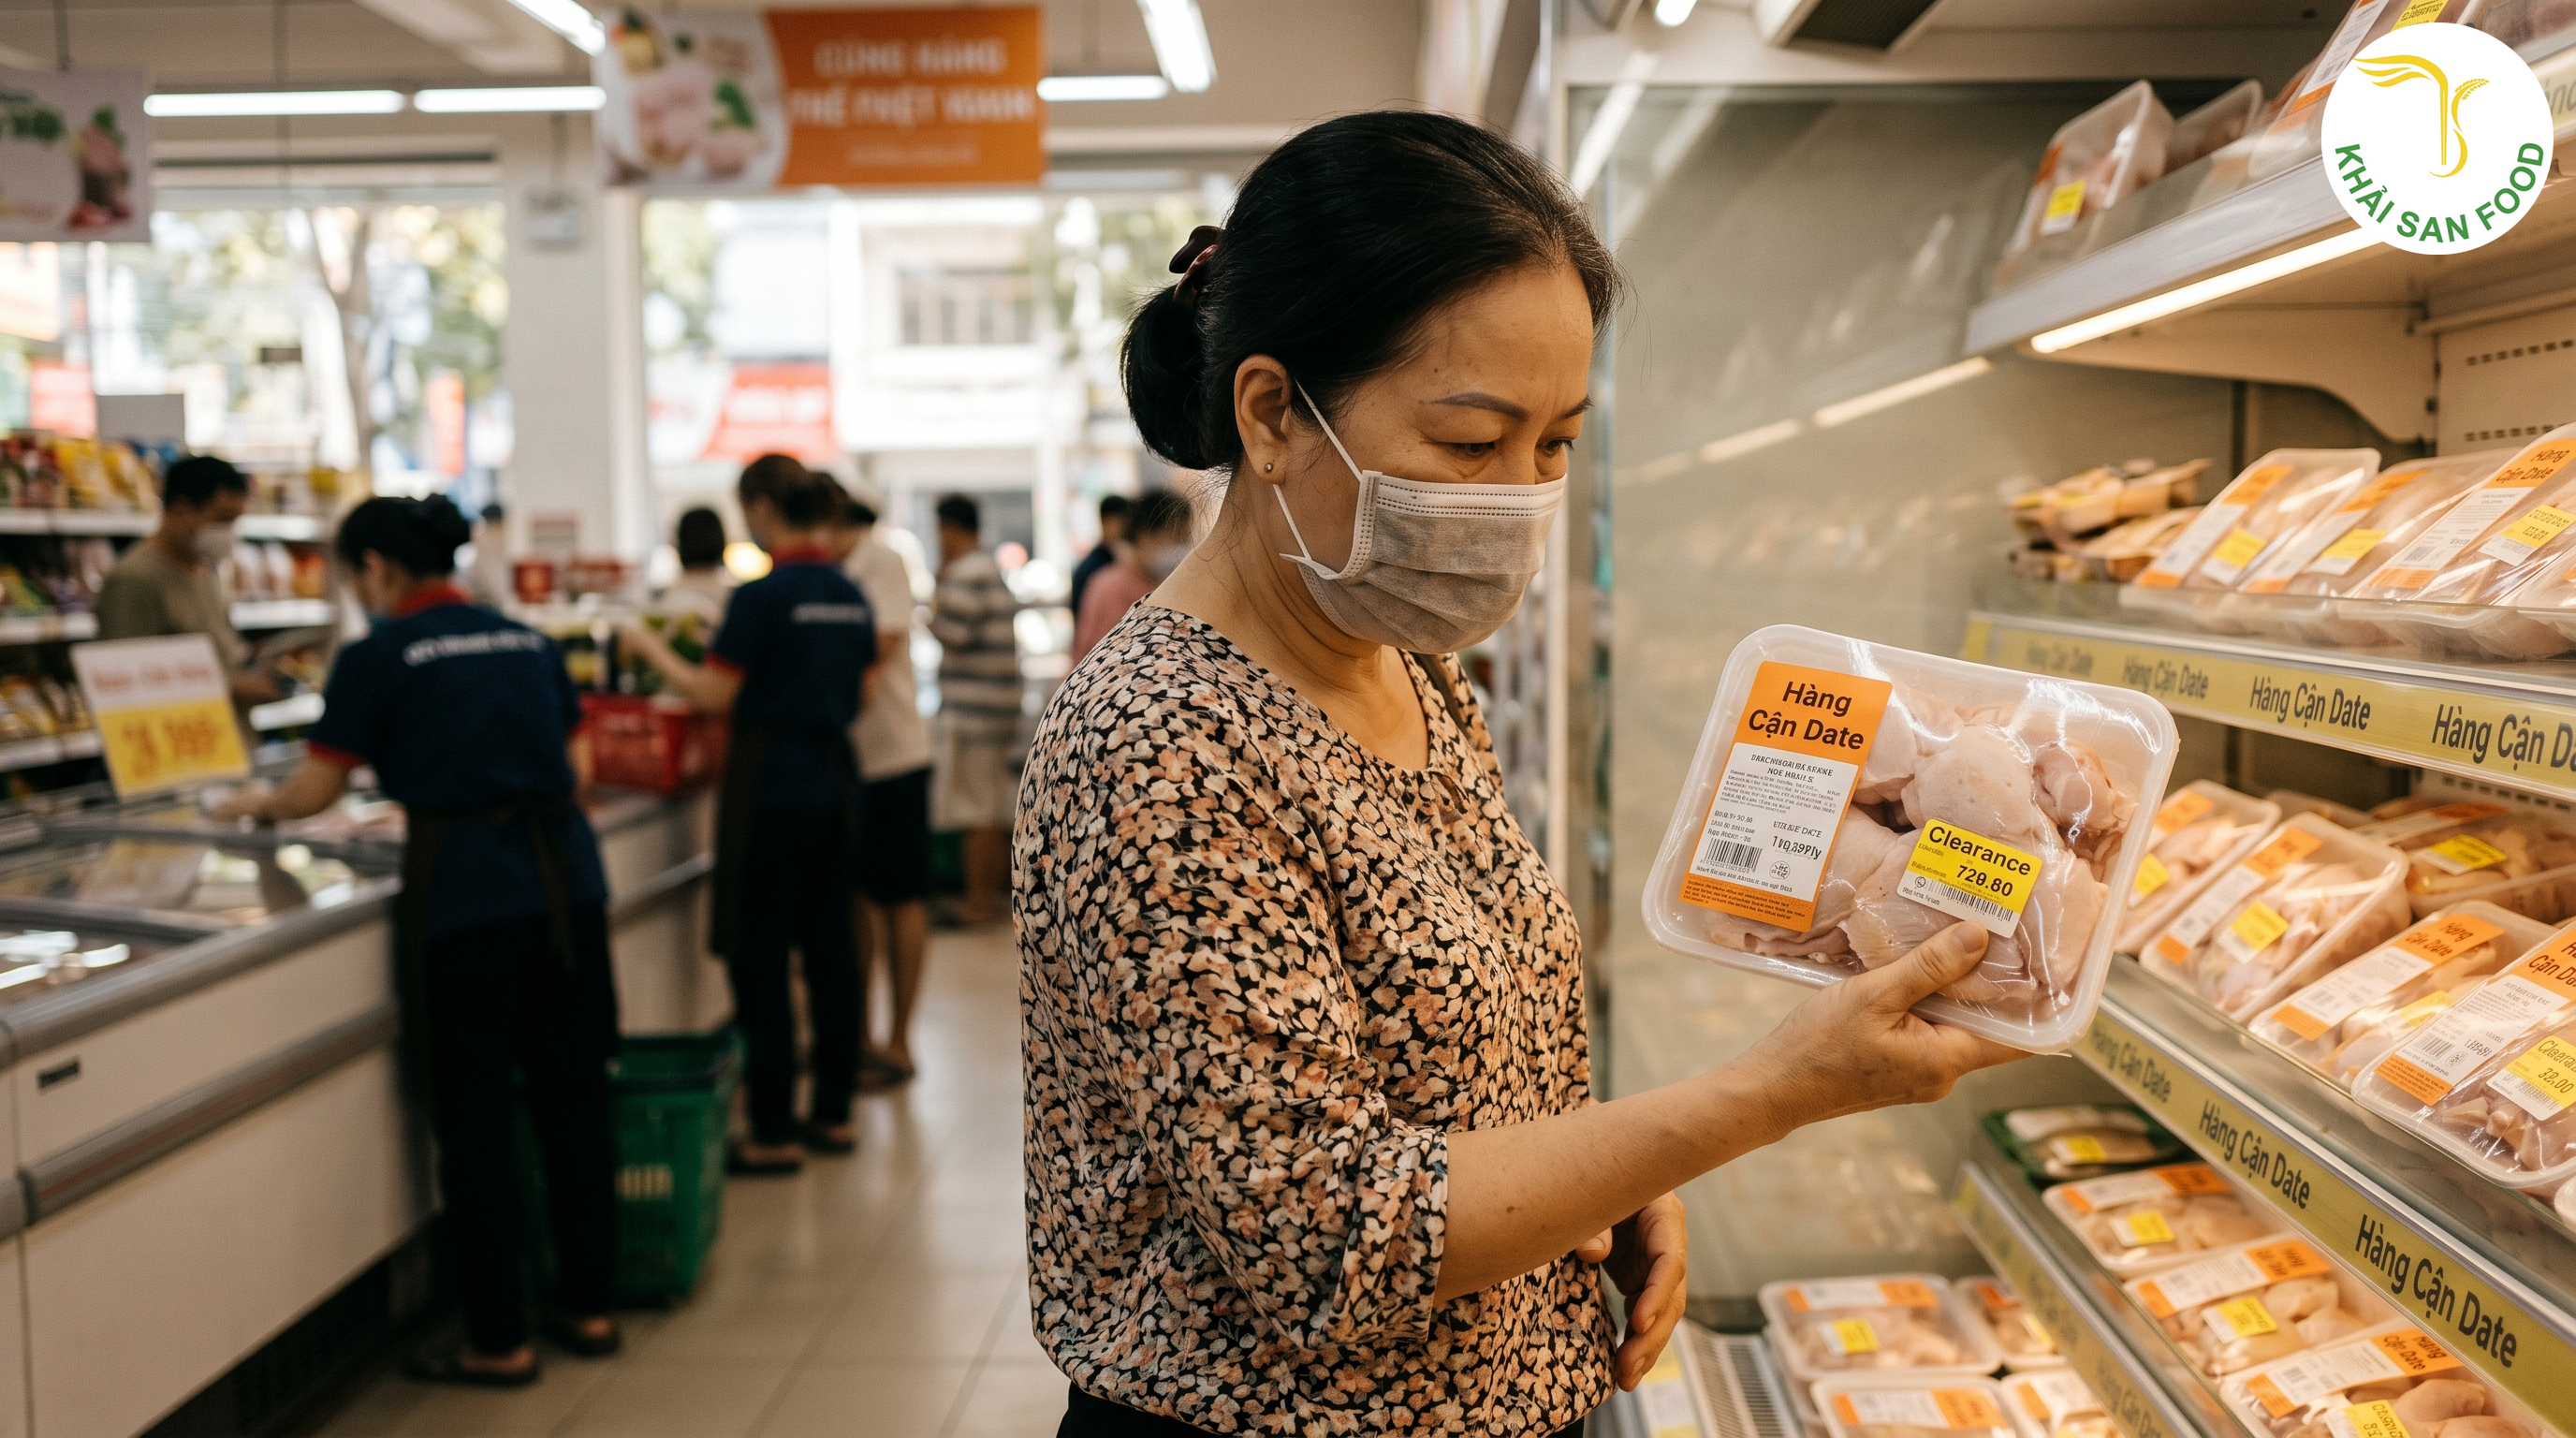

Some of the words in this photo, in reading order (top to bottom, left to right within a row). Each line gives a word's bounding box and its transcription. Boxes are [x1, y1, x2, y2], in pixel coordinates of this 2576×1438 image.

[1782, 681, 1852, 718] Hàng
[2249, 676, 2291, 724] Hàng
[2294, 682, 2326, 728] Cận
[2329, 688, 2371, 730] Date
[1749, 709, 1797, 739] Cận
[1803, 719, 1864, 749] Date
[2432, 703, 2493, 764] Hàng
[2497, 713, 2545, 770] Cận
[1929, 826, 2031, 876] Clearance
[2199, 1099, 2238, 1162] Hàng
[2240, 1130, 2269, 1179] Cận
[2270, 1152, 2310, 1210] Date
[2355, 1213, 2411, 1295] Hàng
[2413, 1257, 2456, 1323] Cận
[2458, 1290, 2517, 1369] Date
